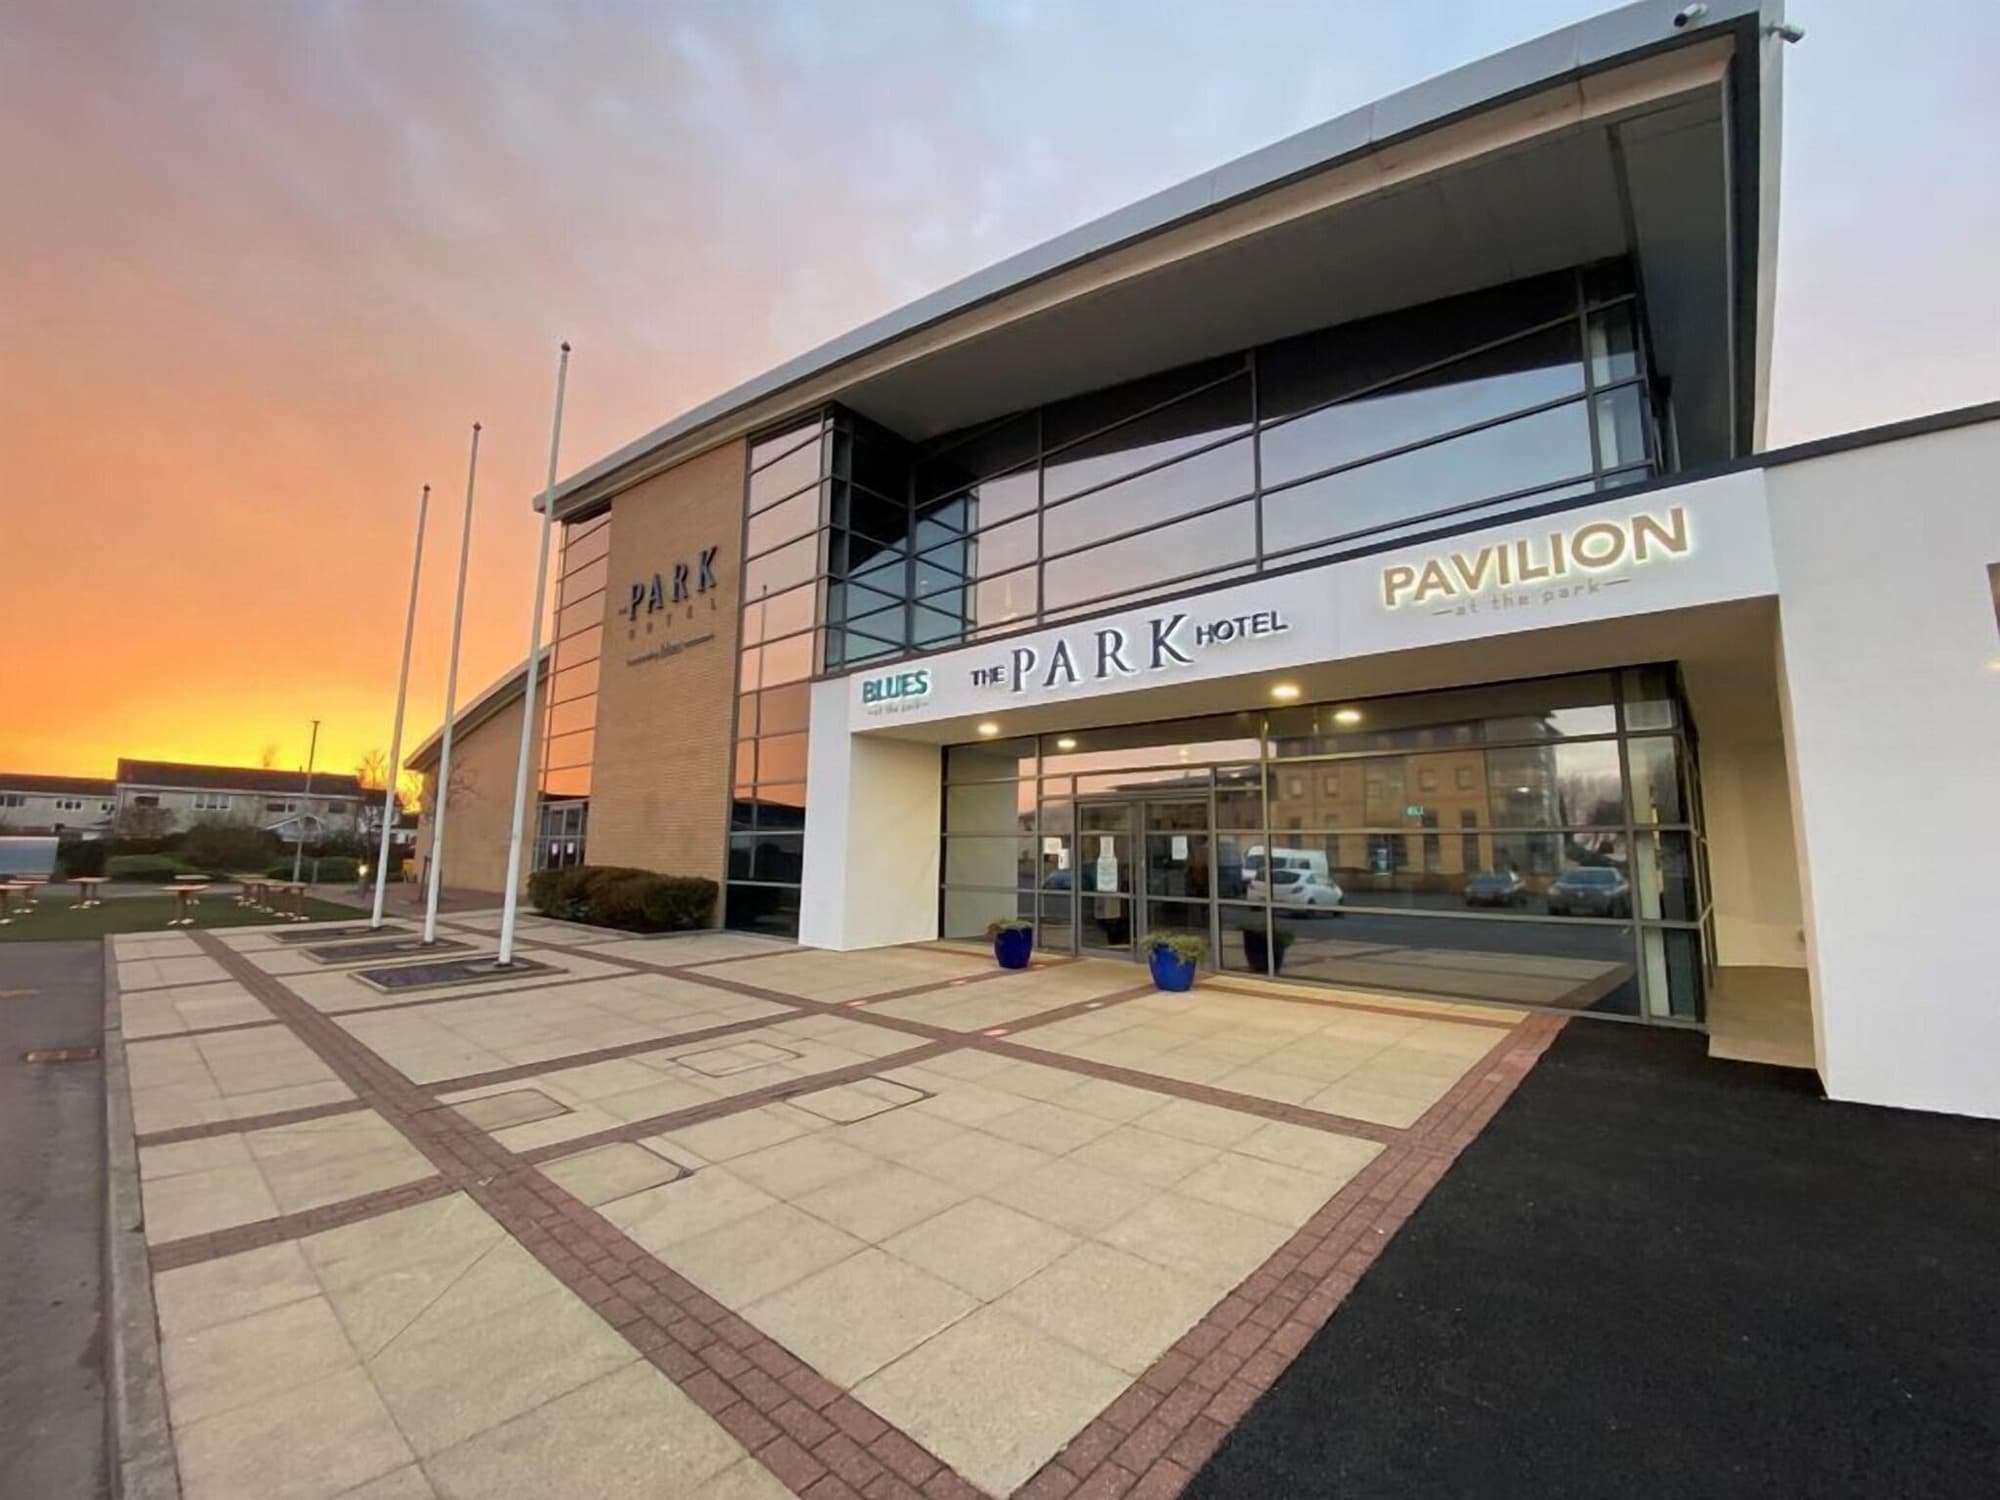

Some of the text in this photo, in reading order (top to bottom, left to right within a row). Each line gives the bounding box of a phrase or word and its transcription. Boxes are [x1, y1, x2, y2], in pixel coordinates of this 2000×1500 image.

[629, 545, 718, 621] PARK
[1383, 507, 1687, 606] PAVILION
[1455, 577, 1600, 616] at the park
[863, 670, 928, 704] BLUES
[970, 611, 1289, 692] THE PARK HOTEL
